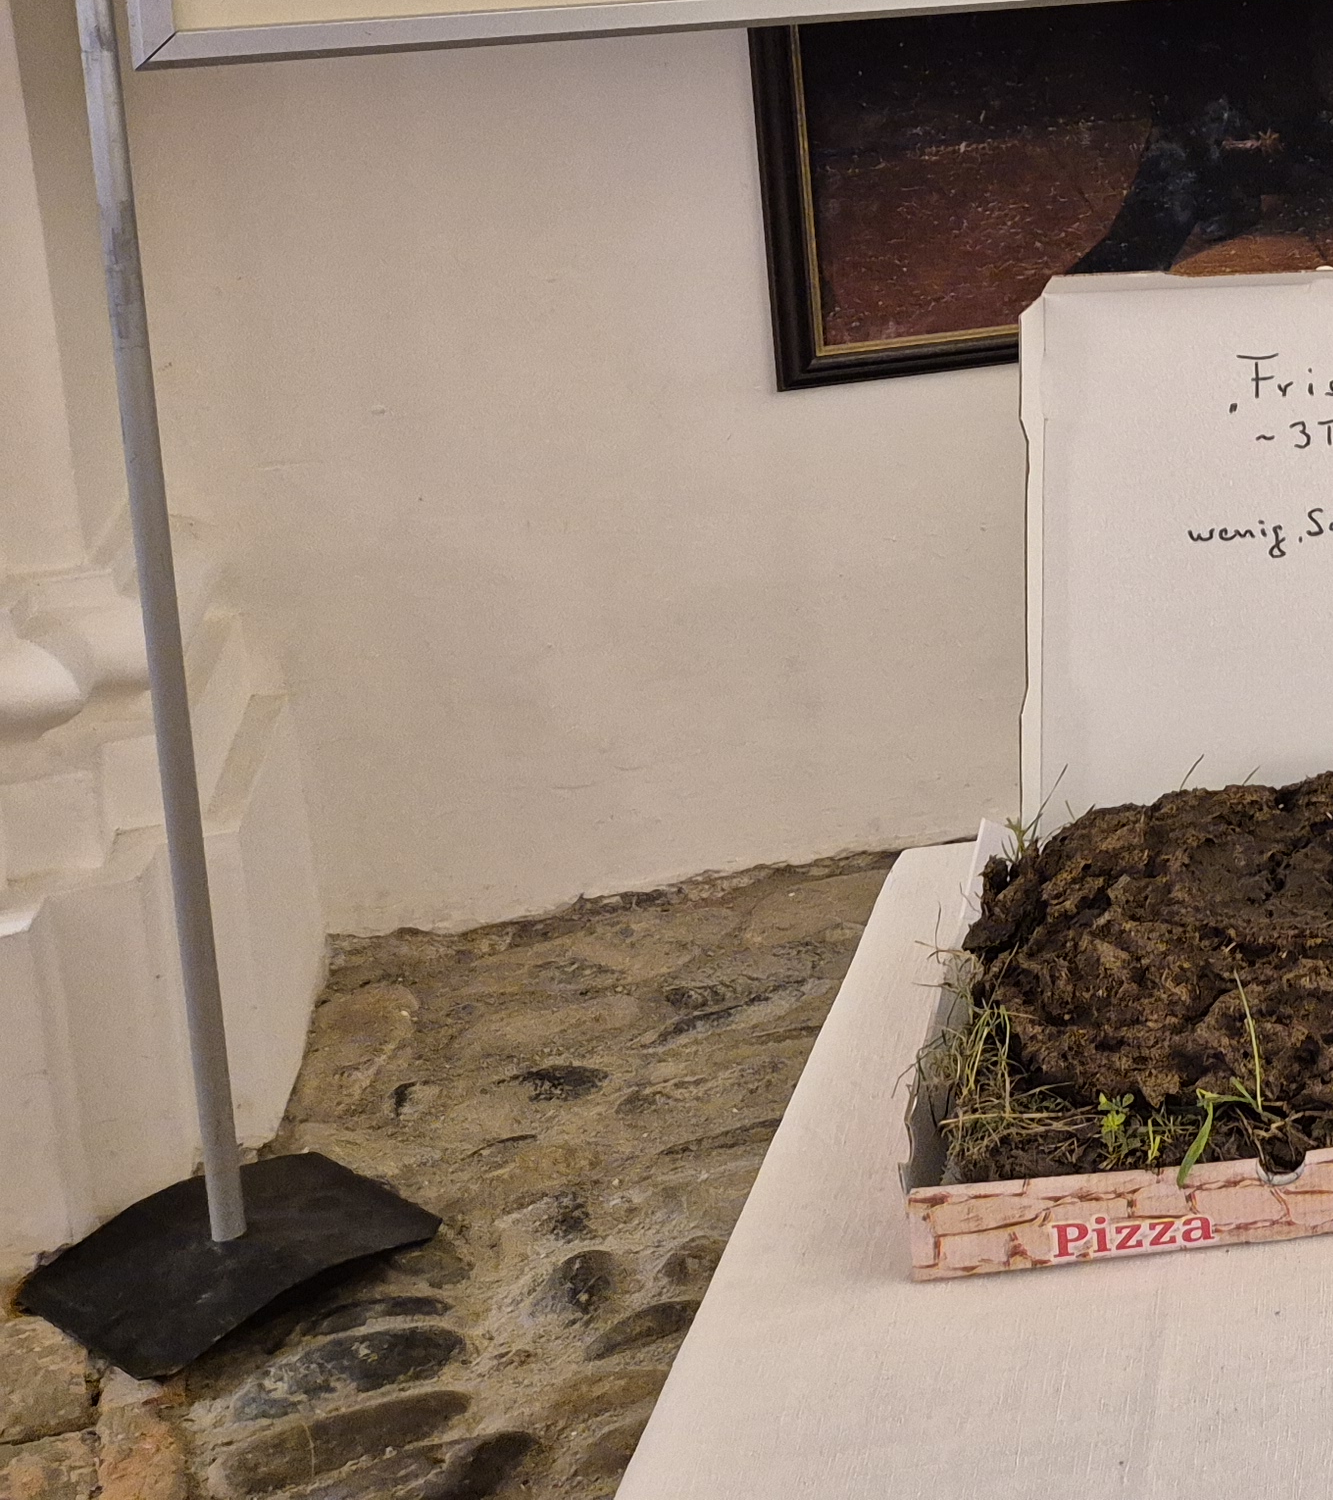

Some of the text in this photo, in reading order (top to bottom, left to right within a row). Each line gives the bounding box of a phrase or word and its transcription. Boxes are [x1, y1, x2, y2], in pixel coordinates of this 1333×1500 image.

[1289, 420, 1312, 449] 3
[1187, 519, 1287, 559] wenig
[1049, 1214, 1218, 1260] Pizza
